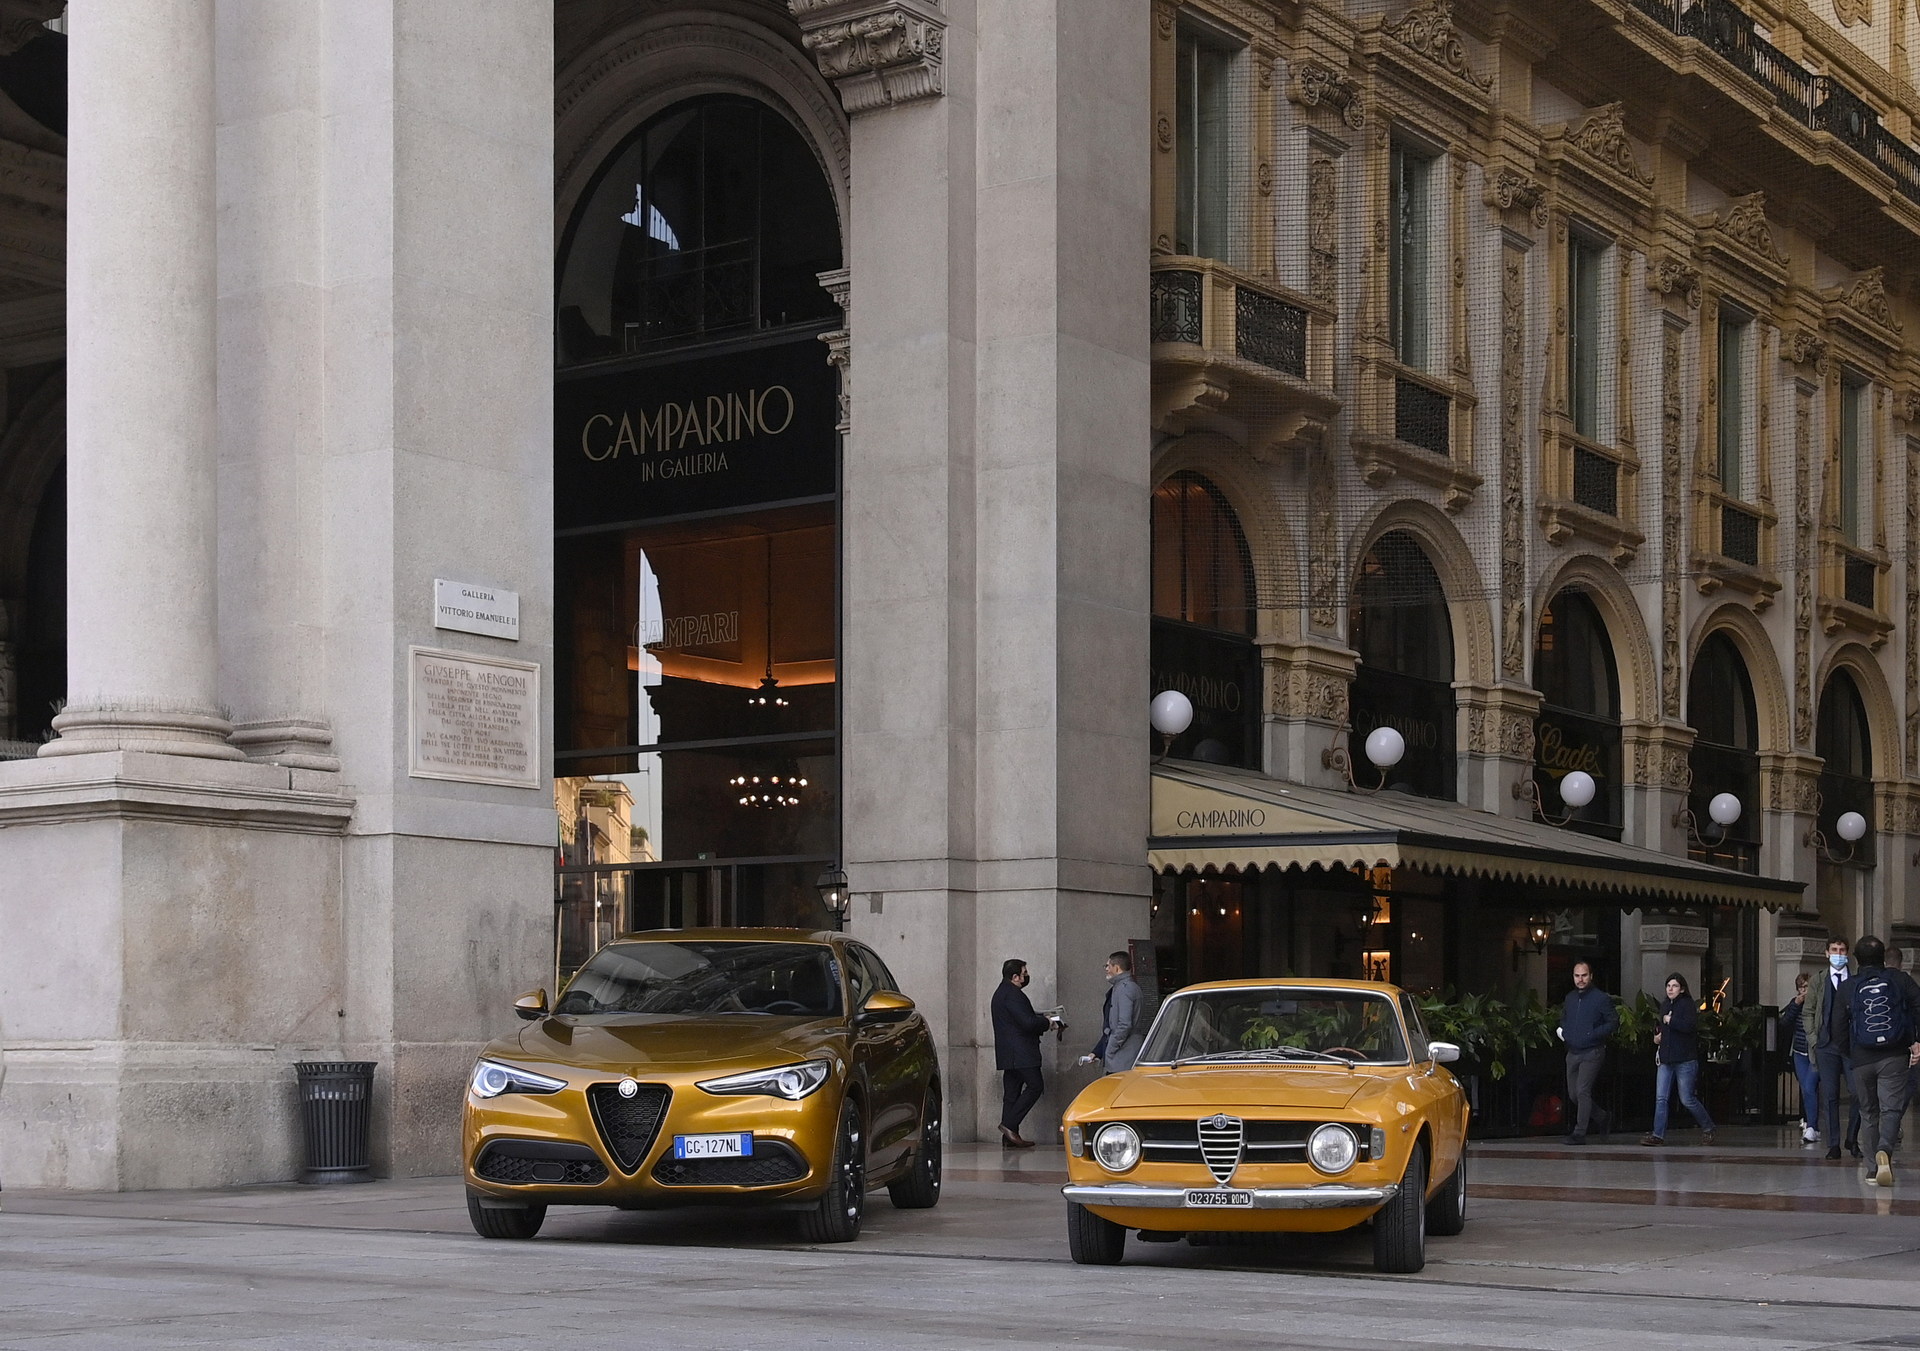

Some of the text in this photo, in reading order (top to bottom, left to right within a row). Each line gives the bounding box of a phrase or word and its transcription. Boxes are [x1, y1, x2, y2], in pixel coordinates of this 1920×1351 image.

[582, 385, 794, 461] CAMPARINO
[642, 452, 728, 482] IN GALLERIA
[462, 589, 494, 601] GALLERIA
[440, 605, 473, 618] VITTORIO
[475, 611, 510, 625] EMANUELE
[476, 671, 525, 689] MENGONI
[1176, 808, 1266, 828] CAMPARINO
[1231, 1194, 1248, 1204] ROMA
